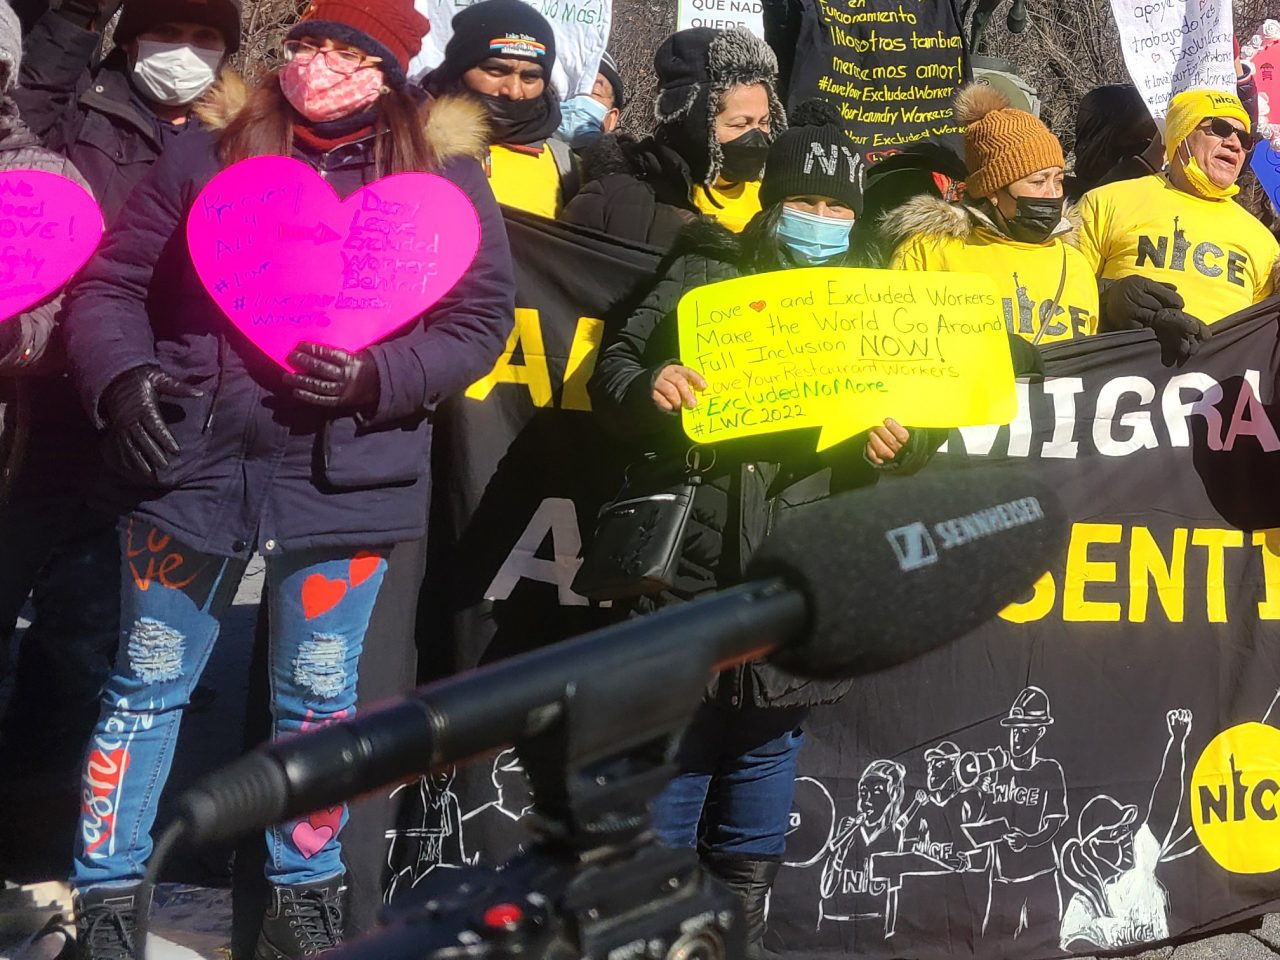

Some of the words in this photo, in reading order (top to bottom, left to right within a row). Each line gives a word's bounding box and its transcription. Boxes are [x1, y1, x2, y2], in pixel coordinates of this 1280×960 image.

[848, 0, 866, 8] en
[932, 124, 969, 137] Work
[1135, 215, 1248, 289] NICE
[695, 300, 744, 328] Love
[780, 290, 815, 309] and
[827, 280, 917, 305] Excluded
[926, 285, 996, 306] Workers
[696, 329, 754, 353] Make
[765, 313, 801, 337] the
[812, 310, 880, 333] World
[893, 307, 929, 334] Go
[937, 313, 1003, 335] Around
[695, 351, 736, 376] Full
[746, 339, 847, 364] Inclusion
[992, 776, 1040, 806] NICE
